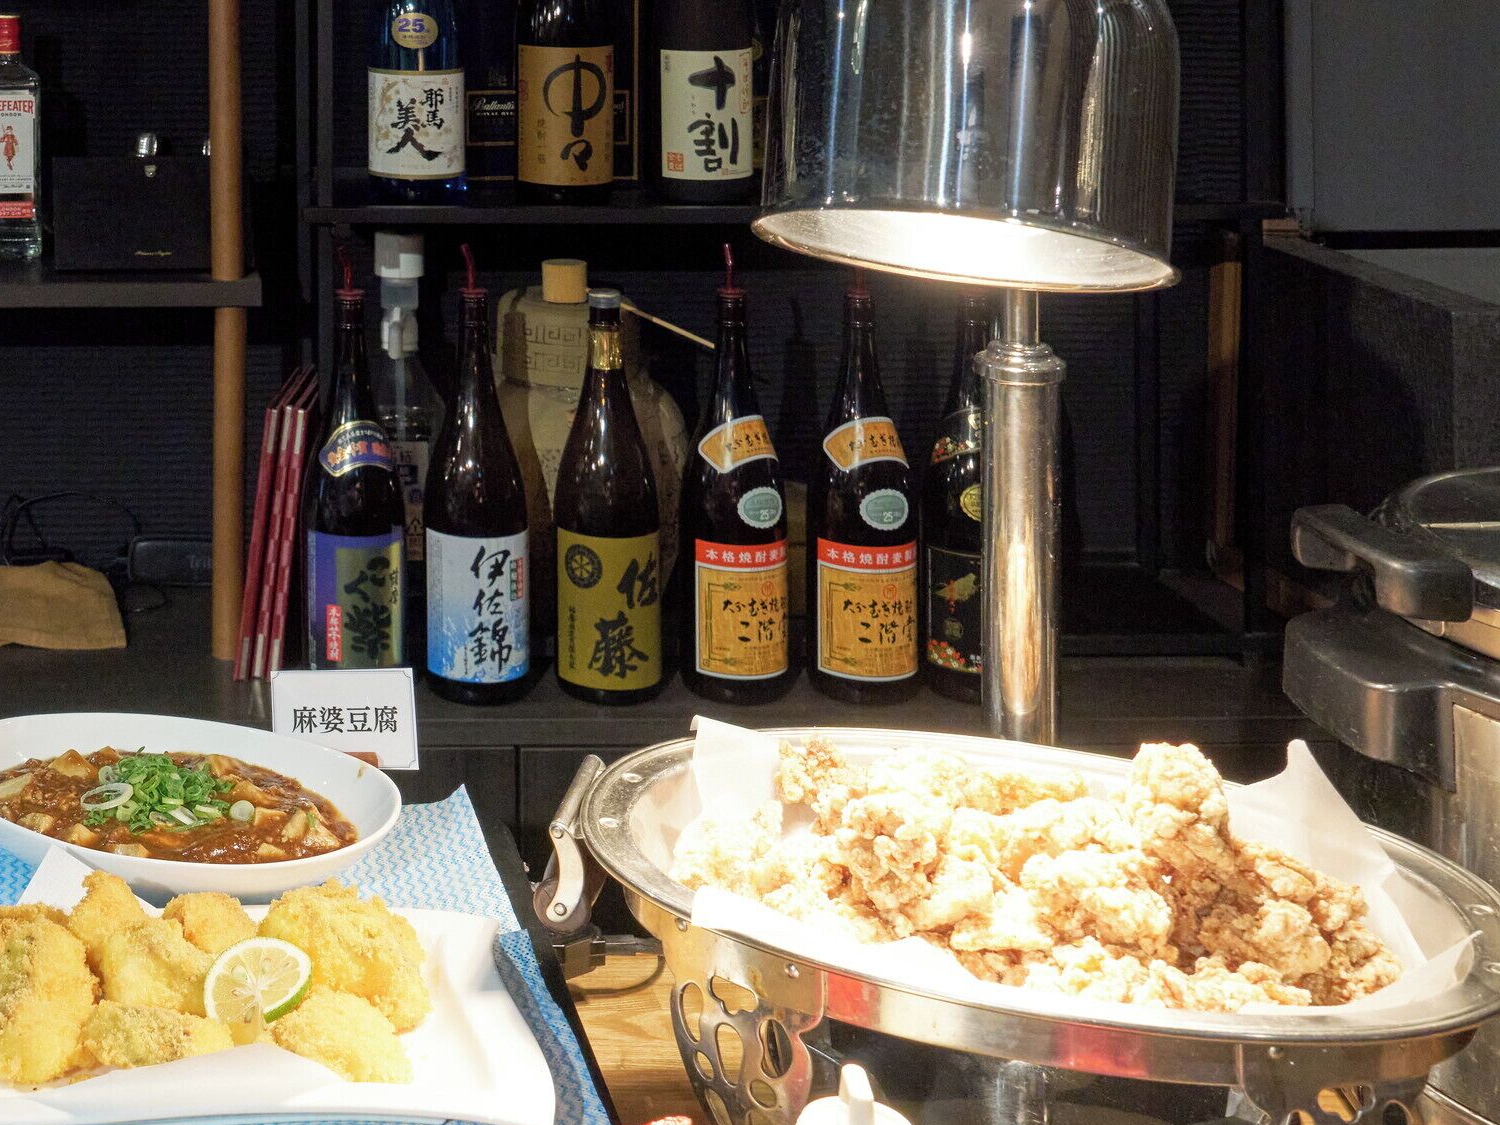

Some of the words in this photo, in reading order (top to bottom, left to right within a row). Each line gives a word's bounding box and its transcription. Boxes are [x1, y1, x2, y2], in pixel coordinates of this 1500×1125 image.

[397, 18, 425, 33] 25
[687, 55, 739, 172] 十割
[468, 545, 513, 675] 伊佐錦
[292, 705, 398, 734] 麻婆豆腐
